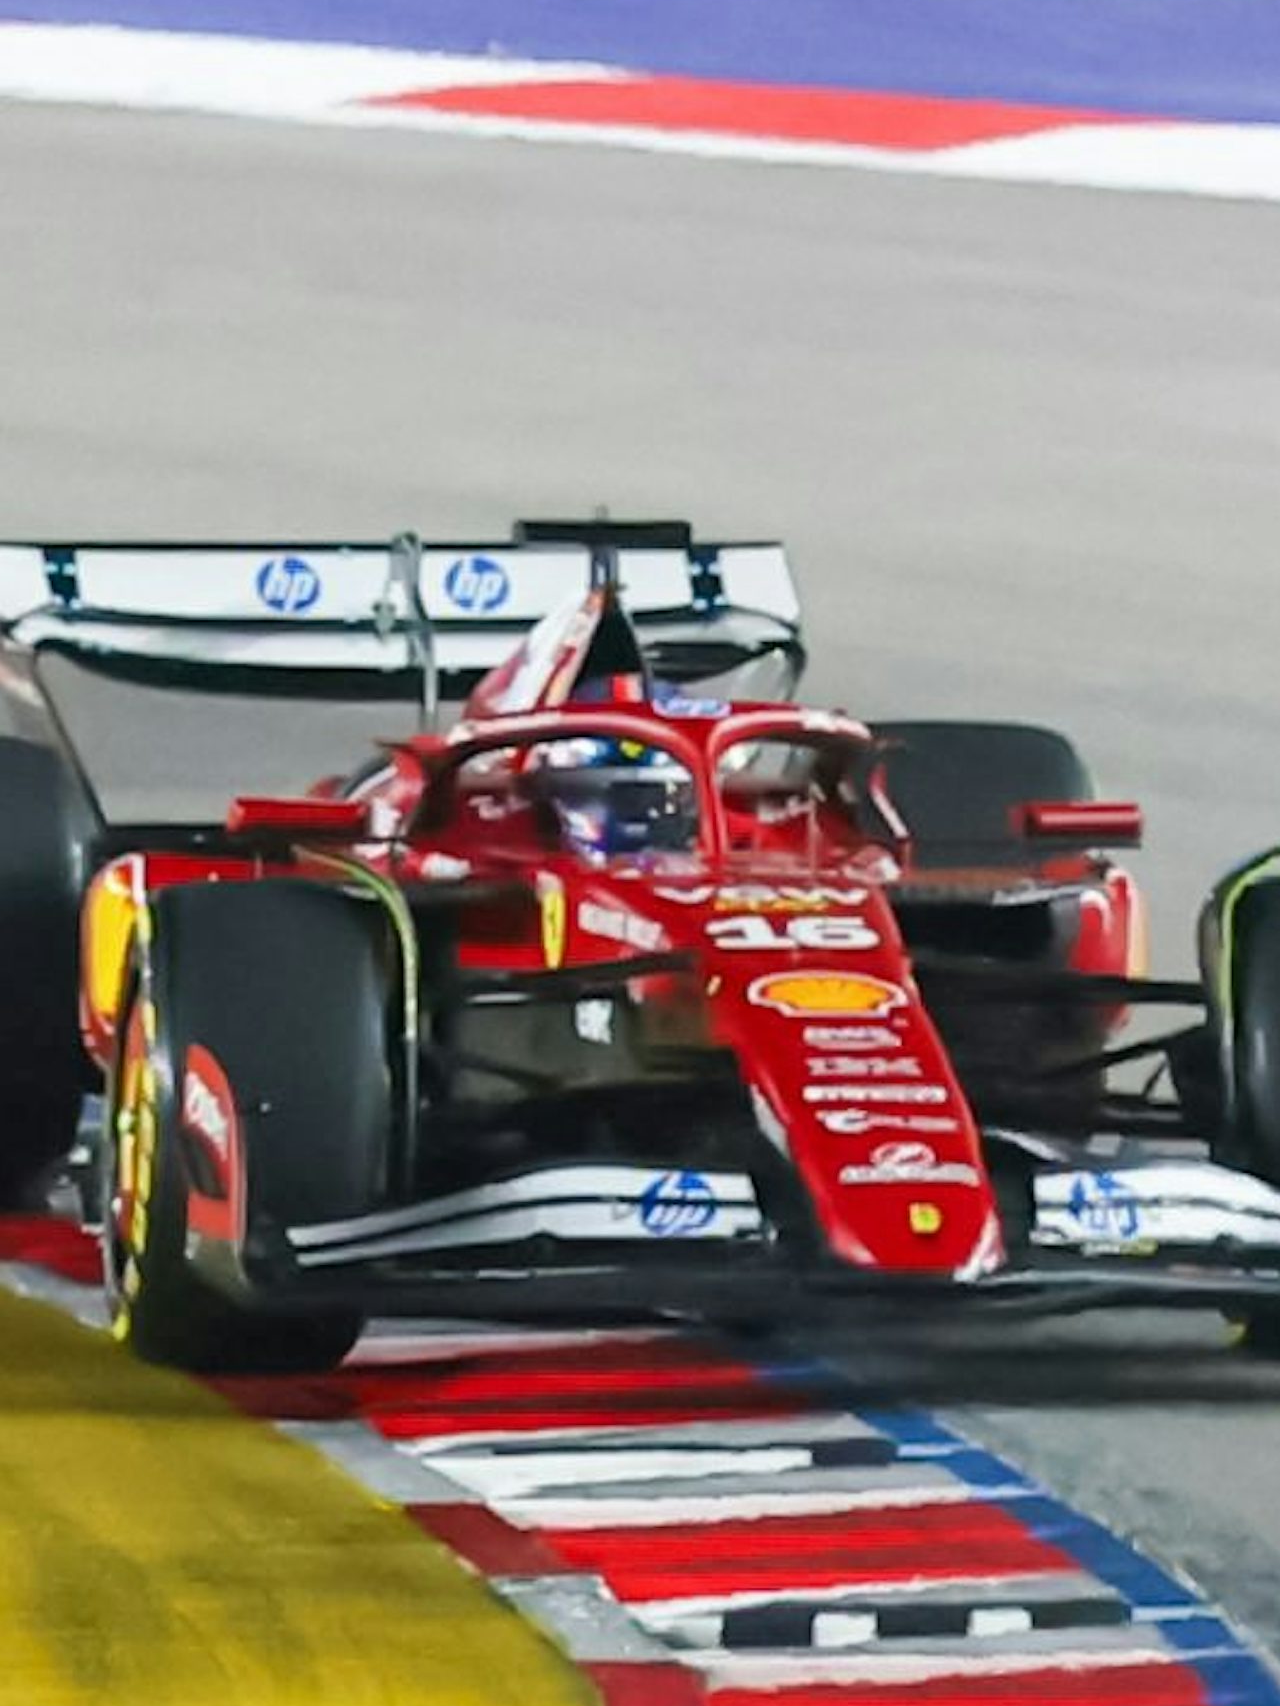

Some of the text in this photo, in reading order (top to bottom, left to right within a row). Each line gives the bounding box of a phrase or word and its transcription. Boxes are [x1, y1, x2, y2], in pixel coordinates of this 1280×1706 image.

[258, 556, 319, 611] hp
[447, 555, 509, 611] hp
[705, 915, 880, 949] 16
